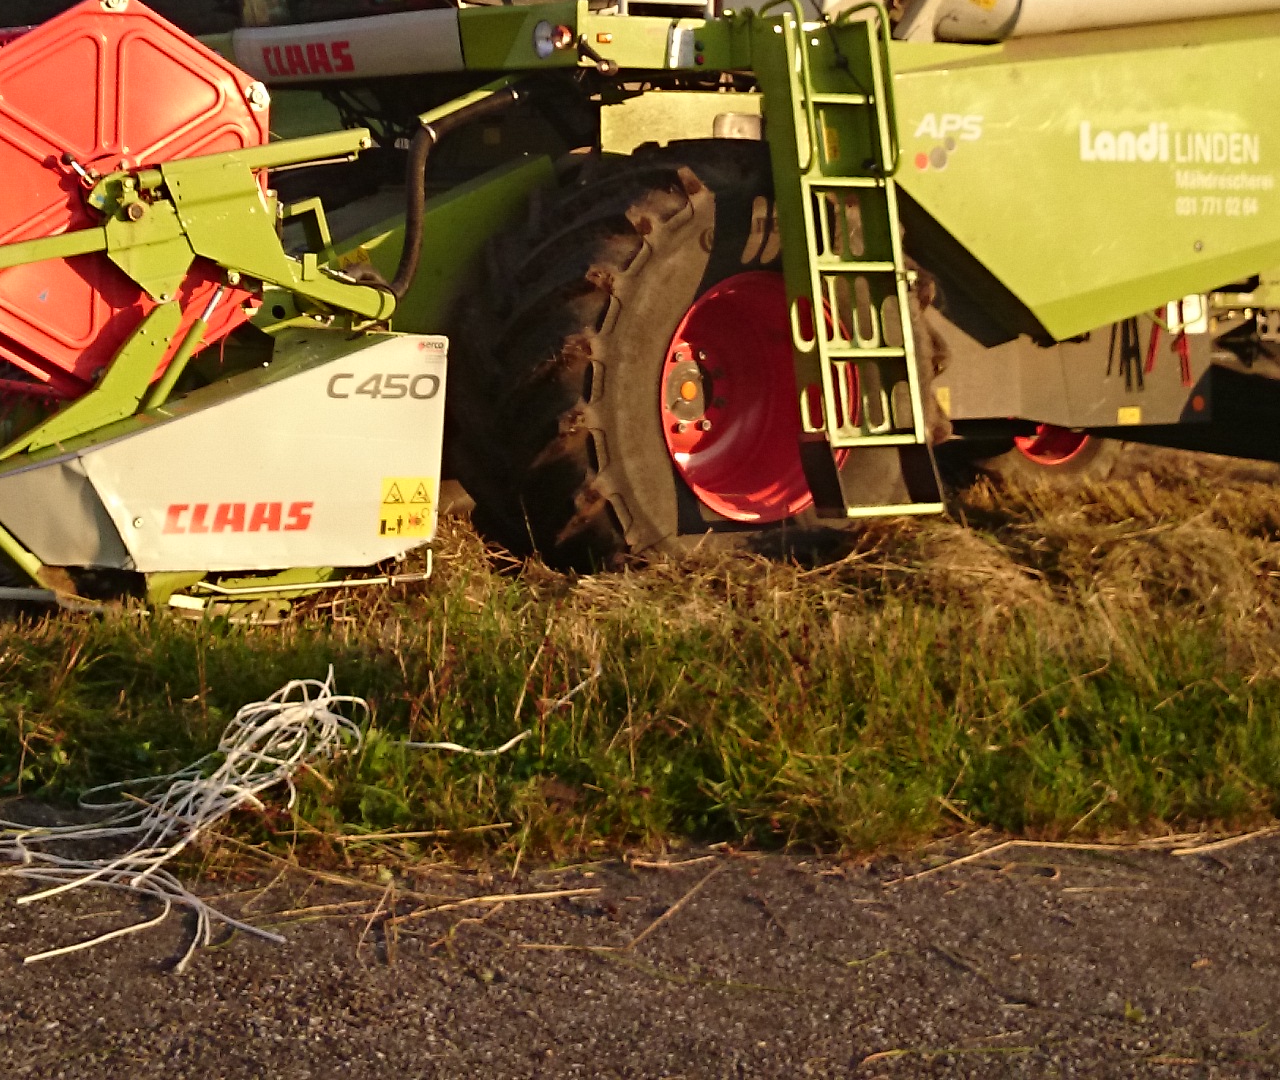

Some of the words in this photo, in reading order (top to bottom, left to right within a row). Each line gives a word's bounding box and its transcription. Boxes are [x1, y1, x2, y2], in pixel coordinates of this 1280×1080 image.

[261, 40, 355, 76] CLAAS
[913, 113, 984, 141] APS
[1079, 121, 1169, 162] Landi
[1174, 132, 1260, 164] LINDEN
[326, 373, 354, 399] C
[355, 373, 440, 400] 450
[162, 501, 314, 534] CLAAS
